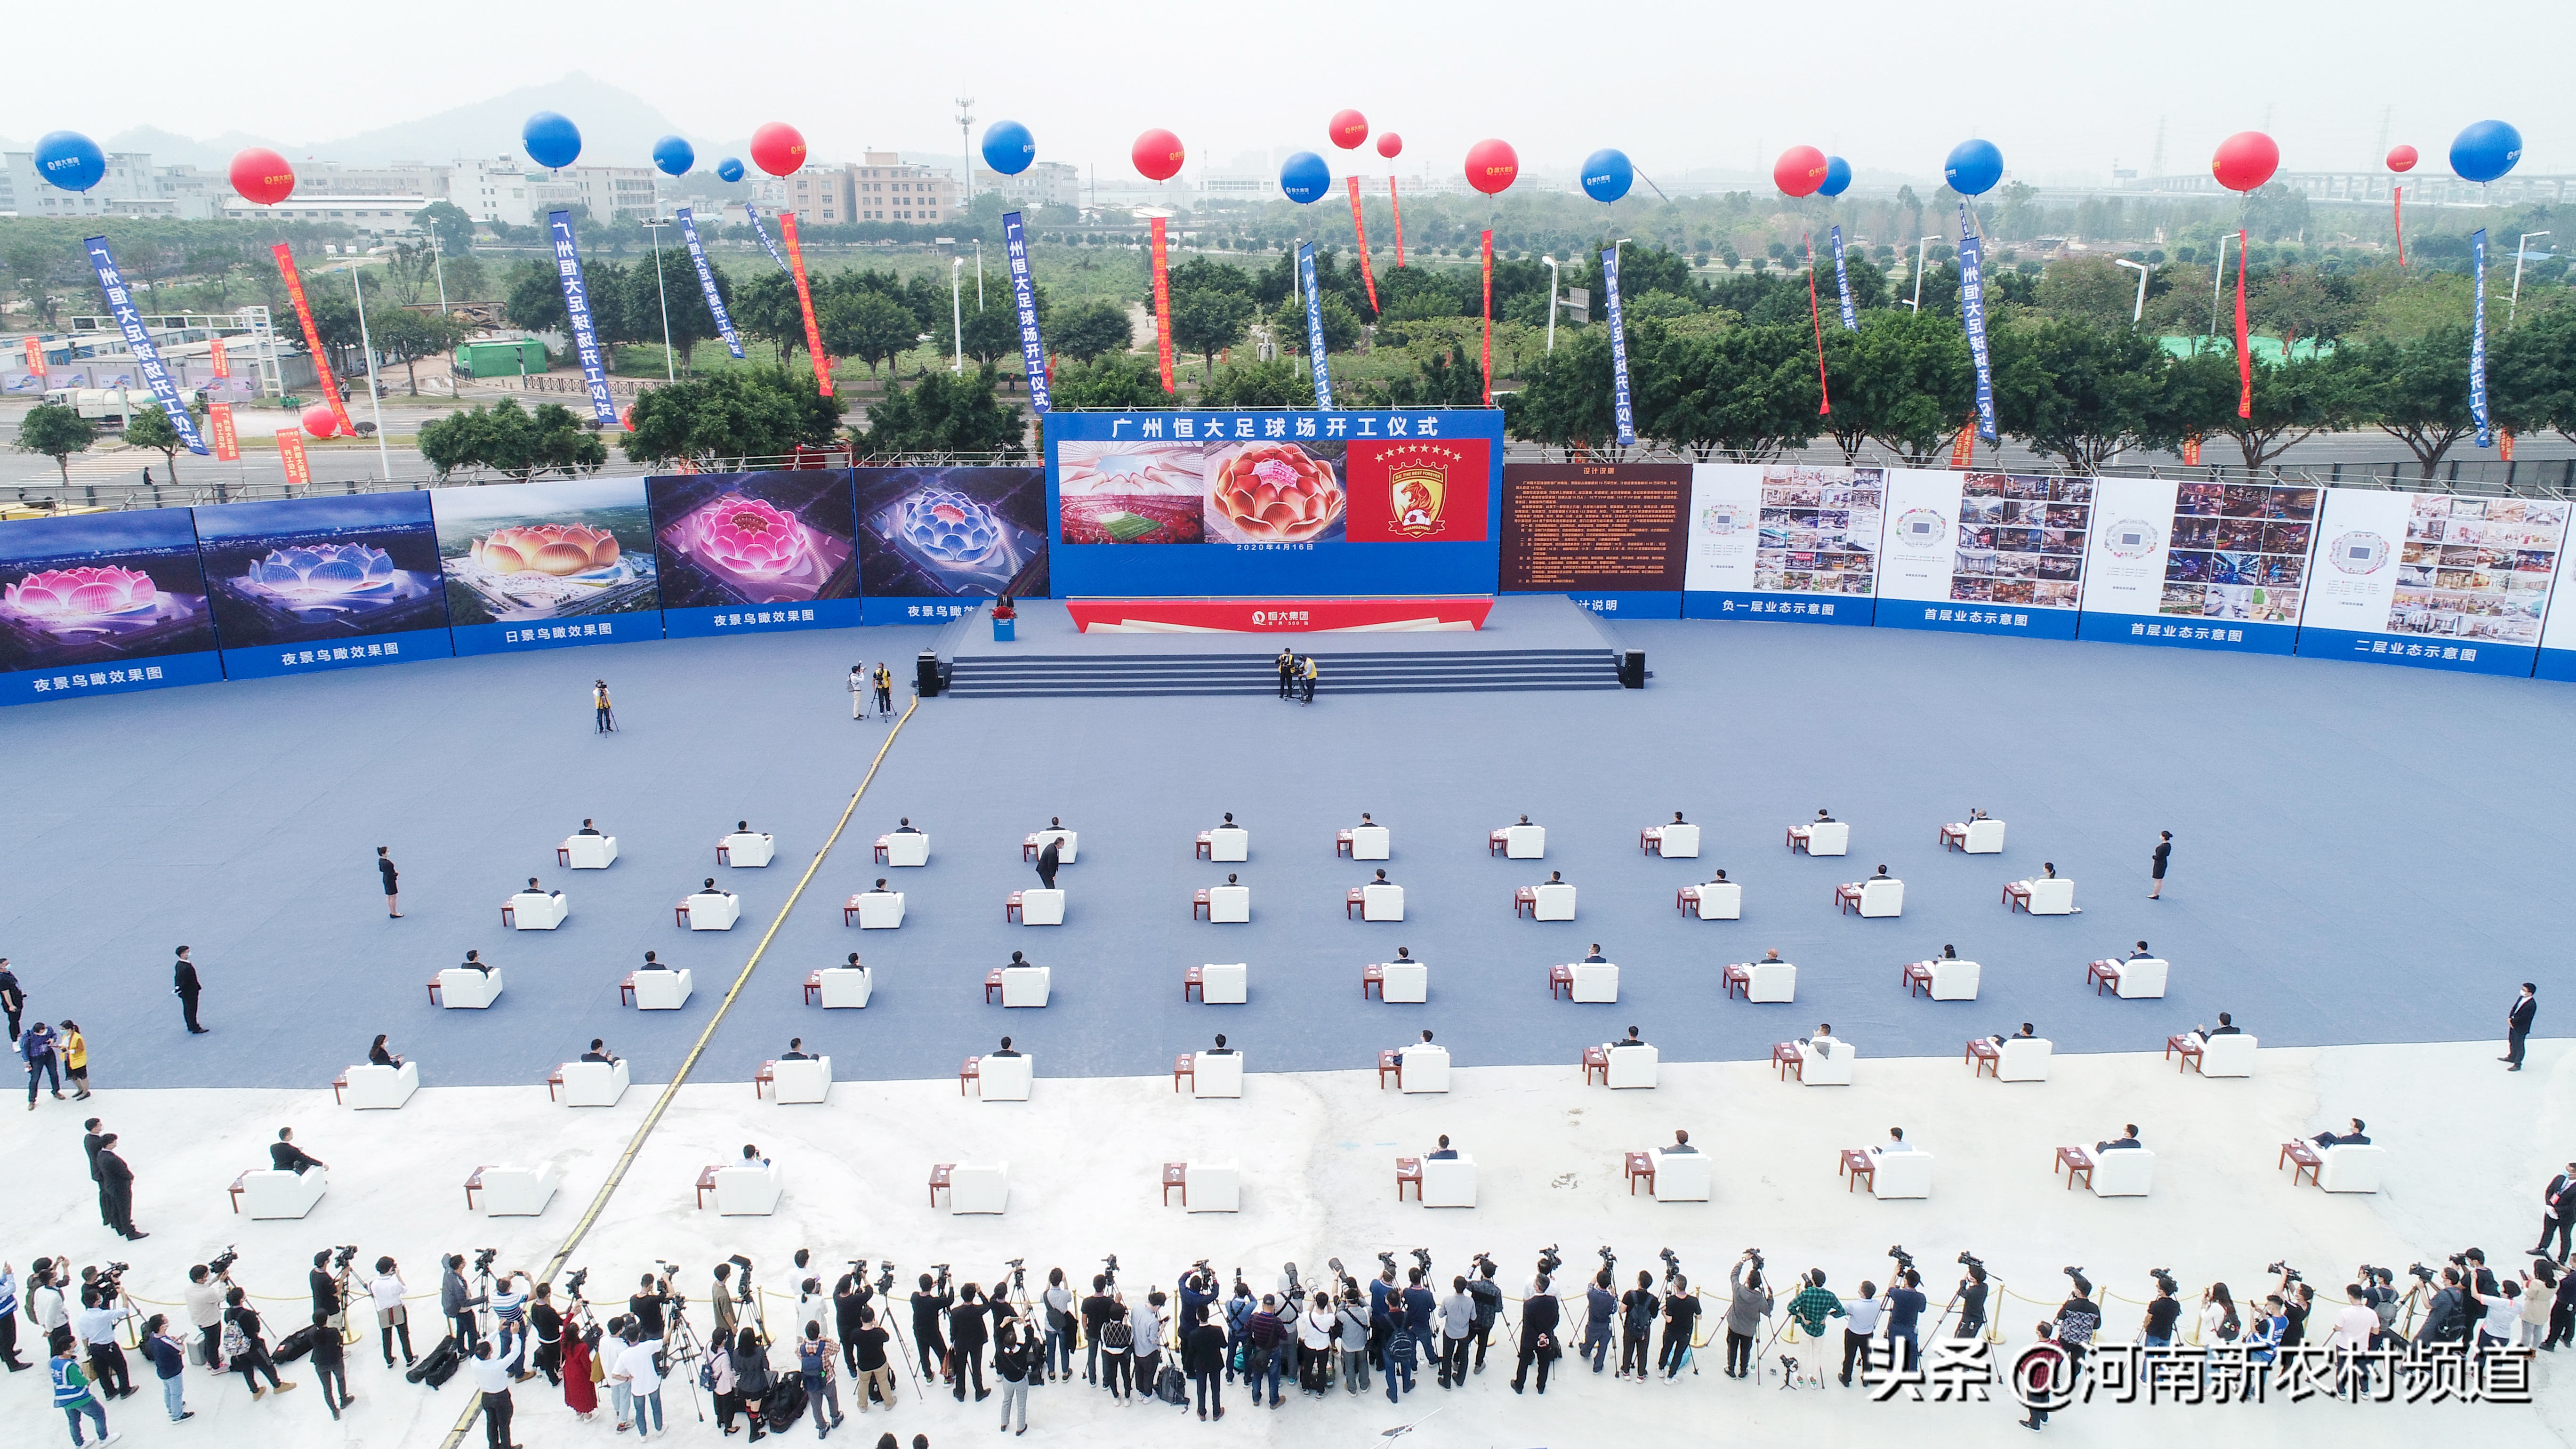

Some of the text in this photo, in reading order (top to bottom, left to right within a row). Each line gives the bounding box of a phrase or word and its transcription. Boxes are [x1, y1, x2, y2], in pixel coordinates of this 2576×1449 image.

[1112, 417, 1439, 438] 广州恒大足球场开工仪式
[713, 609, 815, 628] 夜景鸟瞰效果图
[1268, 611, 1309, 621] 恒大集团
[1722, 599, 1835, 617] 负一层业态示意图
[1924, 608, 2029, 627] 首层业态示意图
[506, 622, 613, 644] 日景鸟瞰效果图
[2131, 623, 2243, 644] 首层业态示意图
[282, 642, 399, 666] 夜景鸟瞰效果图
[2355, 639, 2477, 663] 二层业态示意图
[33, 666, 164, 693] 夜景鸟瞰效果图
